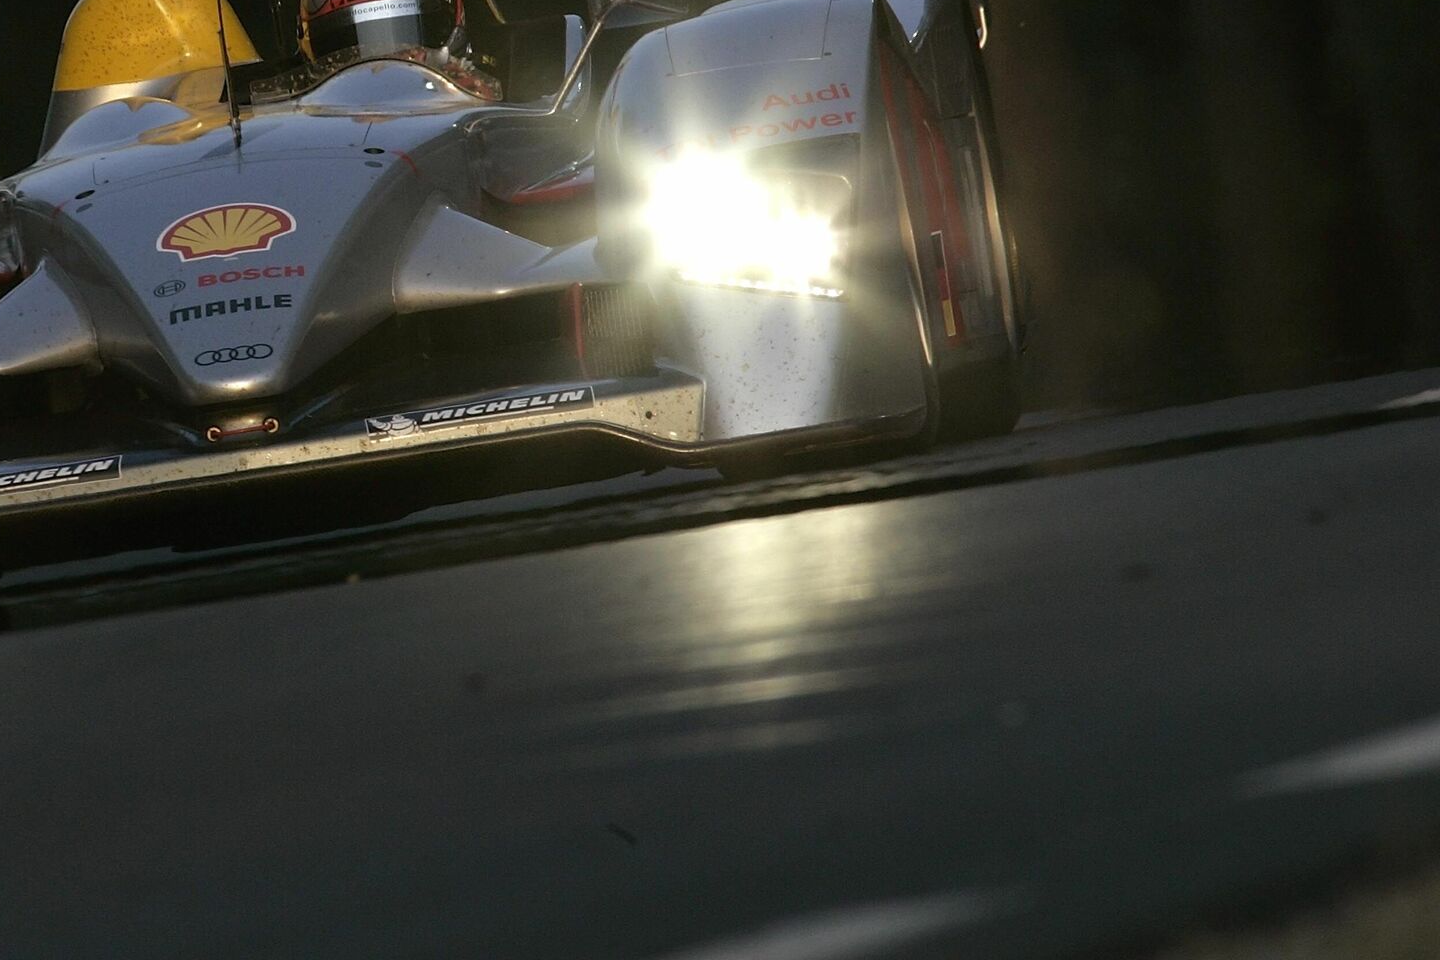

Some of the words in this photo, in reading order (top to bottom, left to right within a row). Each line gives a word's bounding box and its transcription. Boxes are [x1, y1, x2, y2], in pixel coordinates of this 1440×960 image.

[762, 83, 850, 111] Audi
[730, 111, 856, 144] Power
[198, 266, 304, 288] BOSCH
[170, 294, 292, 325] MAHLE
[421, 390, 584, 422] MICHELIN
